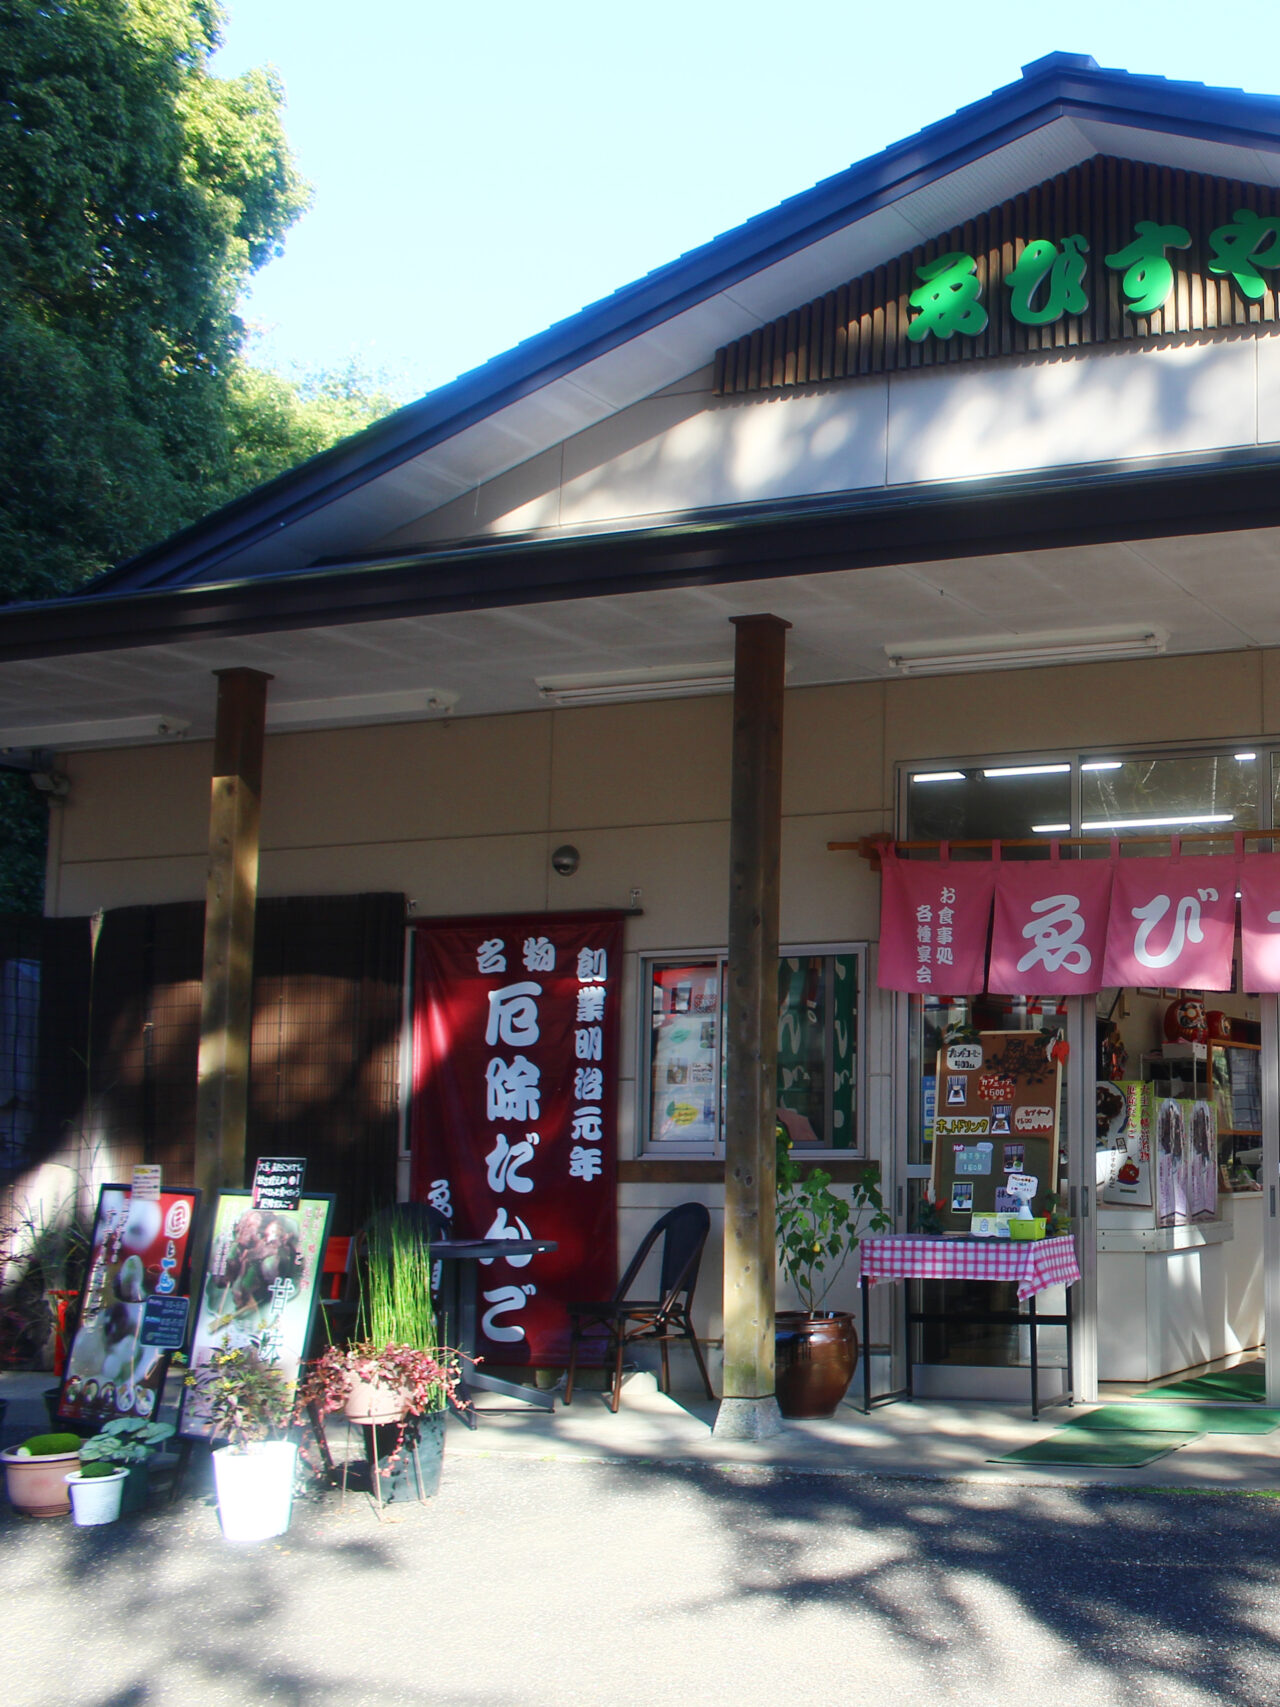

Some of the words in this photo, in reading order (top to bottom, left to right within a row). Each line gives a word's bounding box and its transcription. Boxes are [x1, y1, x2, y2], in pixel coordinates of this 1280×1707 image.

[476, 937, 555, 974] 名物
[916, 905, 933, 983] 各種宴会
[936, 887, 956, 965] お食事処
[569, 947, 607, 1181] 創業明治元年
[481, 981, 542, 1343] 厄除だんご
